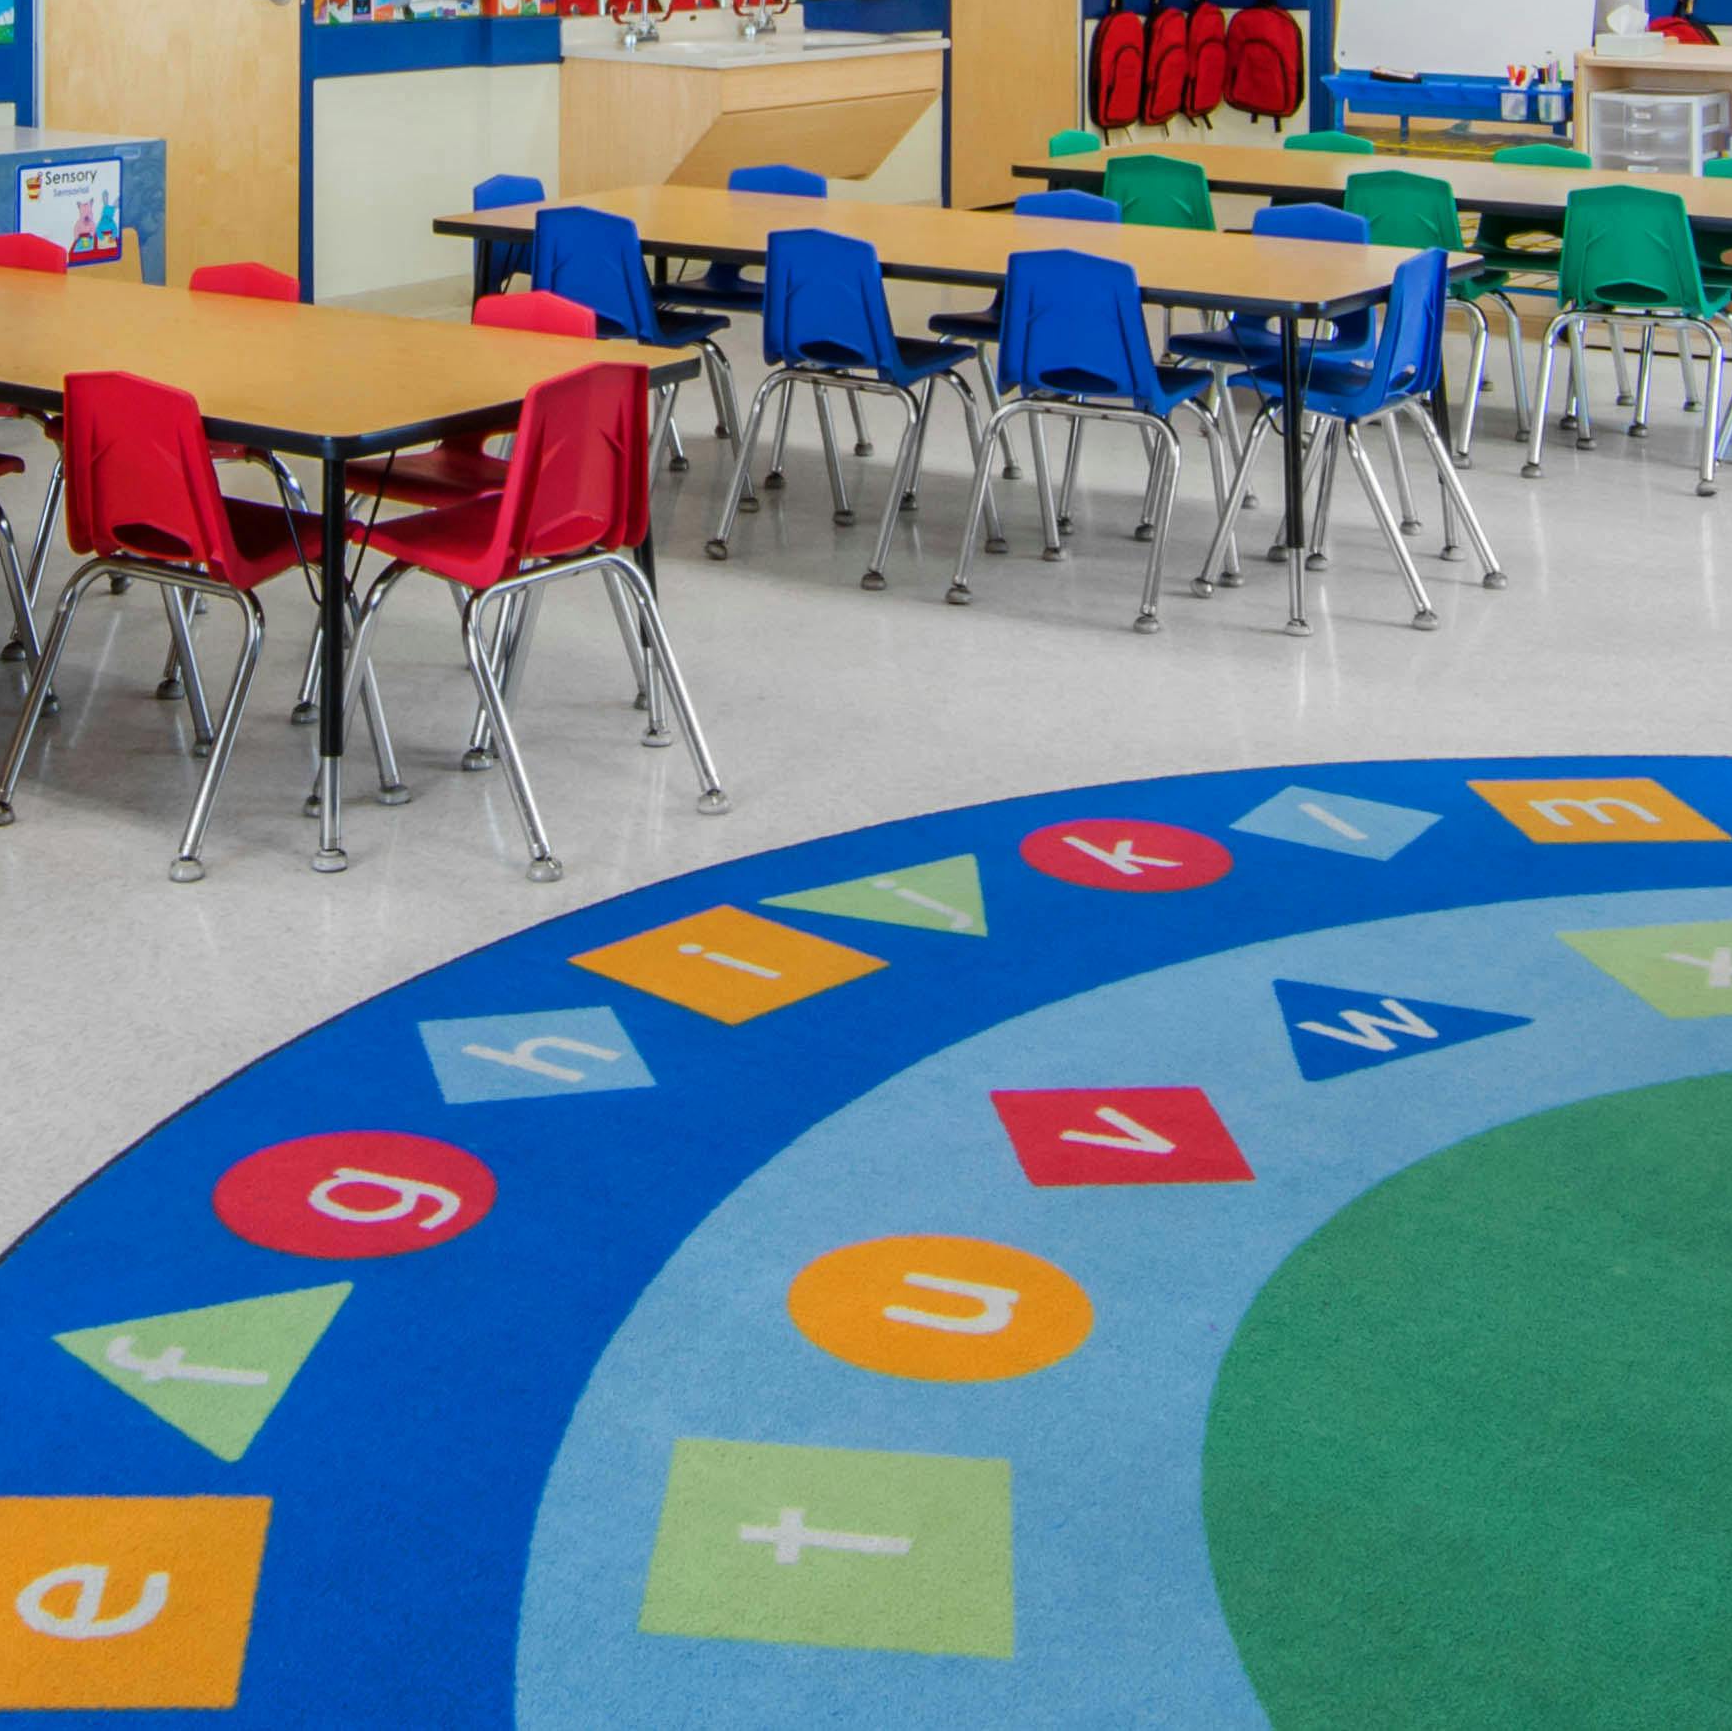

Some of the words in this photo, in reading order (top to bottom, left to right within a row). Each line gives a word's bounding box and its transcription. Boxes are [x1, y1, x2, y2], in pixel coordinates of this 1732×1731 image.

[45, 170, 98, 186] Sensory
[15, 1563, 170, 1642] e
[105, 1334, 270, 1386] f
[307, 1166, 463, 1230] g
[462, 1031, 623, 1084] h
[677, 942, 782, 981] i
[873, 876, 973, 931] j
[1061, 834, 1183, 875] k
[1298, 803, 1368, 841] l
[1529, 797, 1663, 827] m
[738, 1506, 913, 1566] t
[882, 1271, 1021, 1336] u
[1060, 1107, 1176, 1156] v
[1295, 997, 1439, 1052] w
